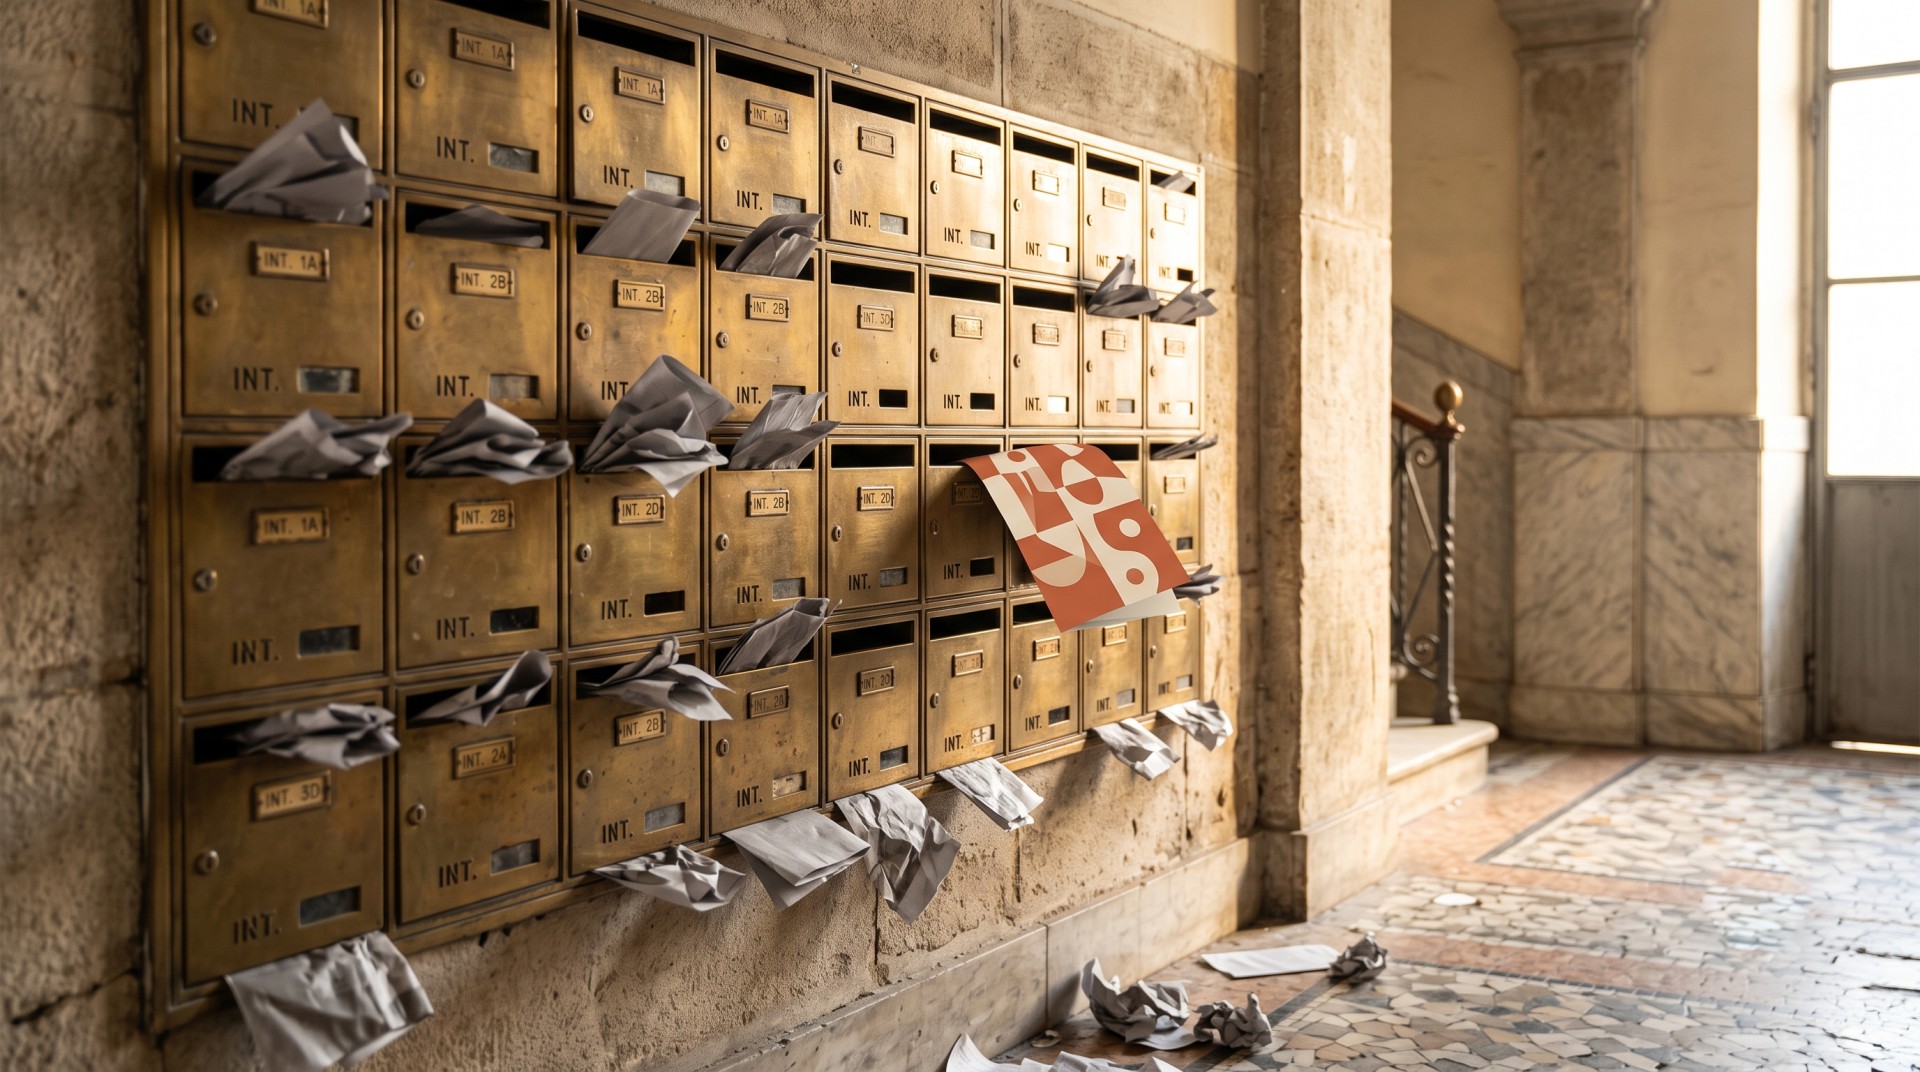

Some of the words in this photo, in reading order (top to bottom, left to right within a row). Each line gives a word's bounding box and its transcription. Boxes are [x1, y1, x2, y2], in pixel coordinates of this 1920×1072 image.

[460, 40, 485, 57] INT.
[491, 46, 507, 62] 1A
[622, 75, 641, 93] INT.
[646, 81, 660, 96] 1A
[231, 98, 281, 130] INT.
[752, 108, 769, 123] INT.
[773, 114, 785, 126] 1A
[436, 136, 475, 164] INT.
[603, 165, 635, 189] INT.
[736, 189, 763, 211] INT.
[849, 209, 872, 229] INT.
[944, 227, 964, 246] INT.
[1025, 241, 1043, 258] INT.
[263, 251, 294, 270] INT.
[300, 255, 318, 271] 1A
[1095, 254, 1112, 270] INT.
[460, 272, 485, 289] INT.
[489, 274, 507, 290] 2B
[622, 287, 642, 302] INT.
[645, 289, 660, 304] 2B
[752, 301, 770, 314] INT.
[772, 303, 785, 315] 2B
[863, 311, 878, 325] INT.
[232, 366, 280, 392] INT.
[436, 375, 475, 398] INT.
[736, 386, 762, 405] INT.
[848, 390, 871, 408] INT.
[943, 394, 963, 410] INT.
[1025, 397, 1042, 412] INT.
[1096, 400, 1111, 414] INT.
[753, 497, 770, 510] INT.
[773, 496, 785, 509] 2B
[863, 492, 878, 505] INT.
[460, 510, 485, 526] INT.
[489, 508, 507, 525] 2B
[621, 503, 641, 518] INT.
[645, 502, 660, 517] 2D
[263, 517, 294, 535] INT.
[301, 516, 319, 533] 1A
[943, 563, 964, 581] INT.
[848, 573, 871, 592] INT.
[736, 584, 763, 605] INT.
[601, 599, 633, 621] INT.
[436, 616, 475, 641] INT.
[231, 638, 280, 666] INT.
[863, 676, 878, 690] INT.
[753, 696, 770, 712] INT.
[1096, 698, 1112, 713] INT.
[622, 721, 642, 738] INT.
[646, 719, 660, 734] 2B
[1025, 715, 1042, 732] INT.
[944, 734, 964, 753] INT.
[462, 753, 485, 770] INT.
[491, 748, 507, 764] 2A
[849, 757, 871, 778] INT.
[264, 788, 294, 810] INT.
[300, 782, 321, 801] 3D
[737, 785, 763, 808] INT.
[602, 819, 633, 844] INT.
[438, 859, 477, 888] INT.
[232, 911, 282, 945] INT.
